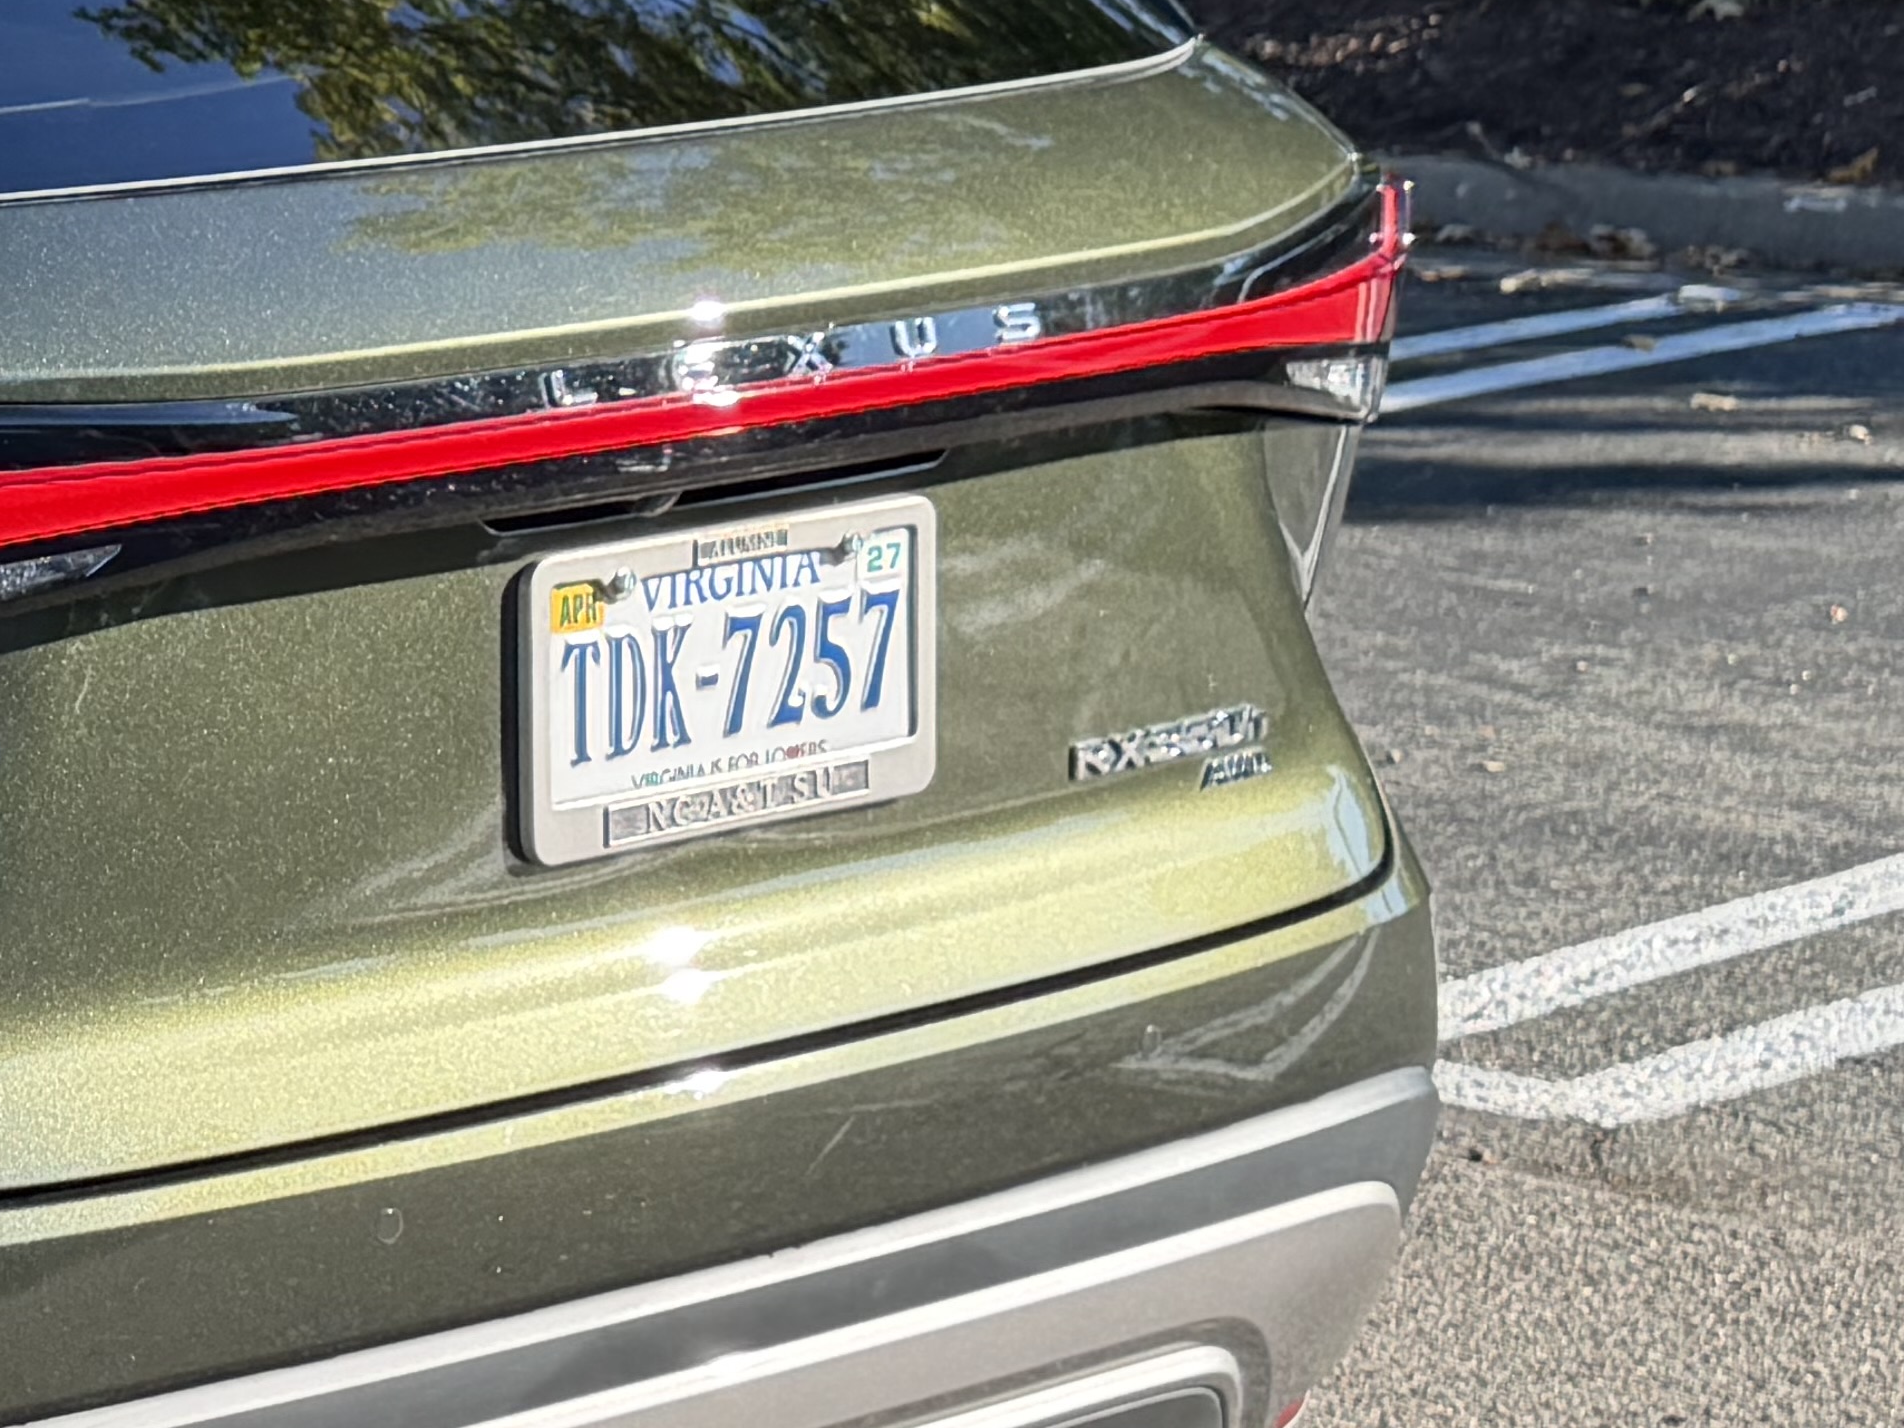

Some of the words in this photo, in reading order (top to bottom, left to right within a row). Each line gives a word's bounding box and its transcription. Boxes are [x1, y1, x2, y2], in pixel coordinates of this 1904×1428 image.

[541, 302, 1042, 408] LEXUS
[641, 551, 822, 612] VIRGINIA
[866, 542, 902, 573] 27
[560, 592, 597, 627] APR
[560, 586, 901, 768] TDK-7257
[631, 762, 706, 790] VIRGINIA
[728, 750, 759, 773] FOR
